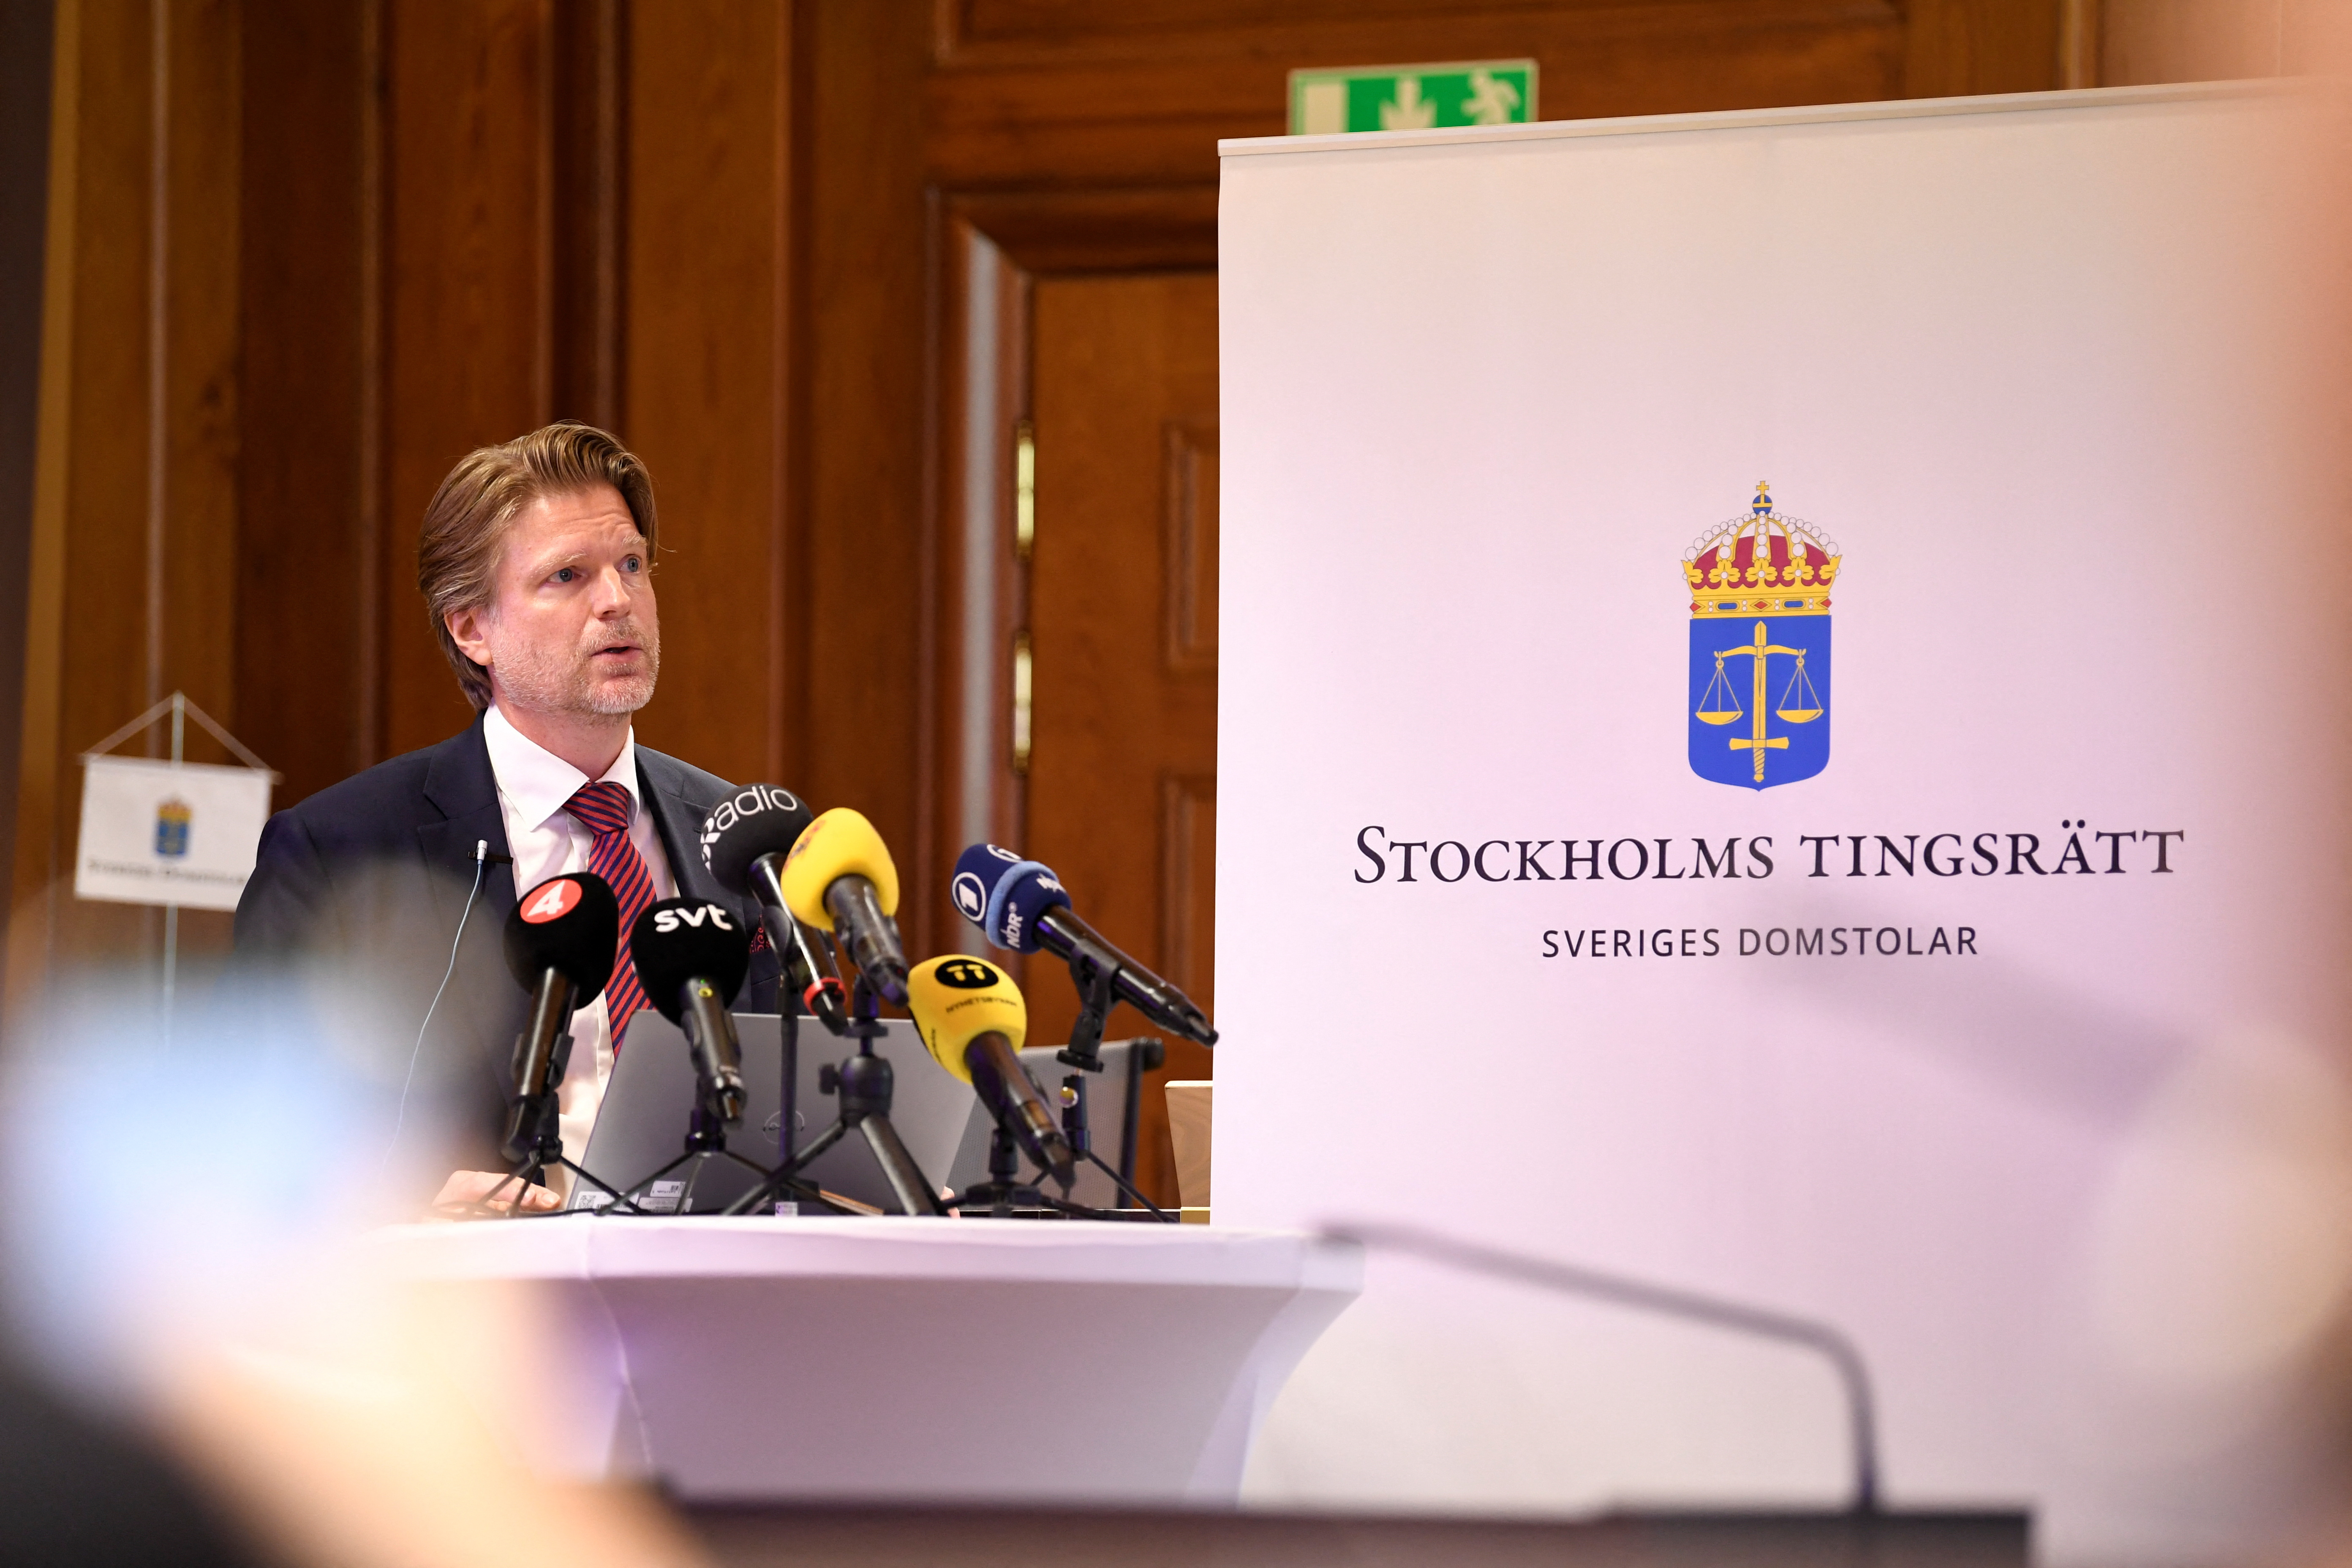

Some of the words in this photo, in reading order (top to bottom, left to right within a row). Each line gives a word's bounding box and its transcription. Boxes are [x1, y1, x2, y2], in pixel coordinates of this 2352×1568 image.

[1354, 825, 1774, 884] STOCKHOLMS
[1799, 819, 2185, 877] TINGSRÄTT
[527, 880, 566, 917] 4
[654, 904, 733, 933] svt
[1542, 928, 1720, 958] SVERIGES
[1739, 926, 1978, 956] DOMSTOLAR
